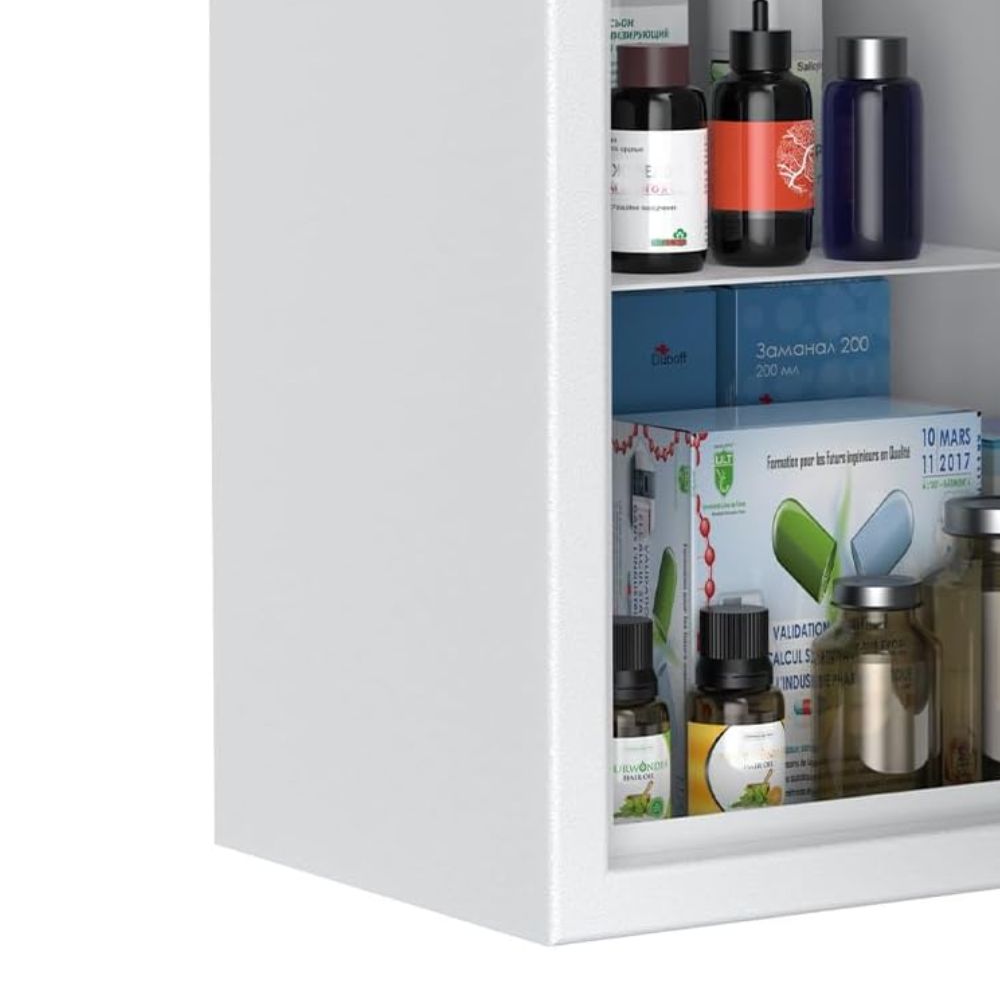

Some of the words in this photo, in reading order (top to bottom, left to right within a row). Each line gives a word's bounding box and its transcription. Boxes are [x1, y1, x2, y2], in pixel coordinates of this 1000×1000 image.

[756, 341, 836, 360] Заманал
[840, 335, 870, 354] 200
[756, 364, 778, 379] 200
[922, 427, 936, 447] 10
[939, 427, 971, 447] MARS
[922, 454, 933, 475] 11
[939, 452, 971, 472] 2017
